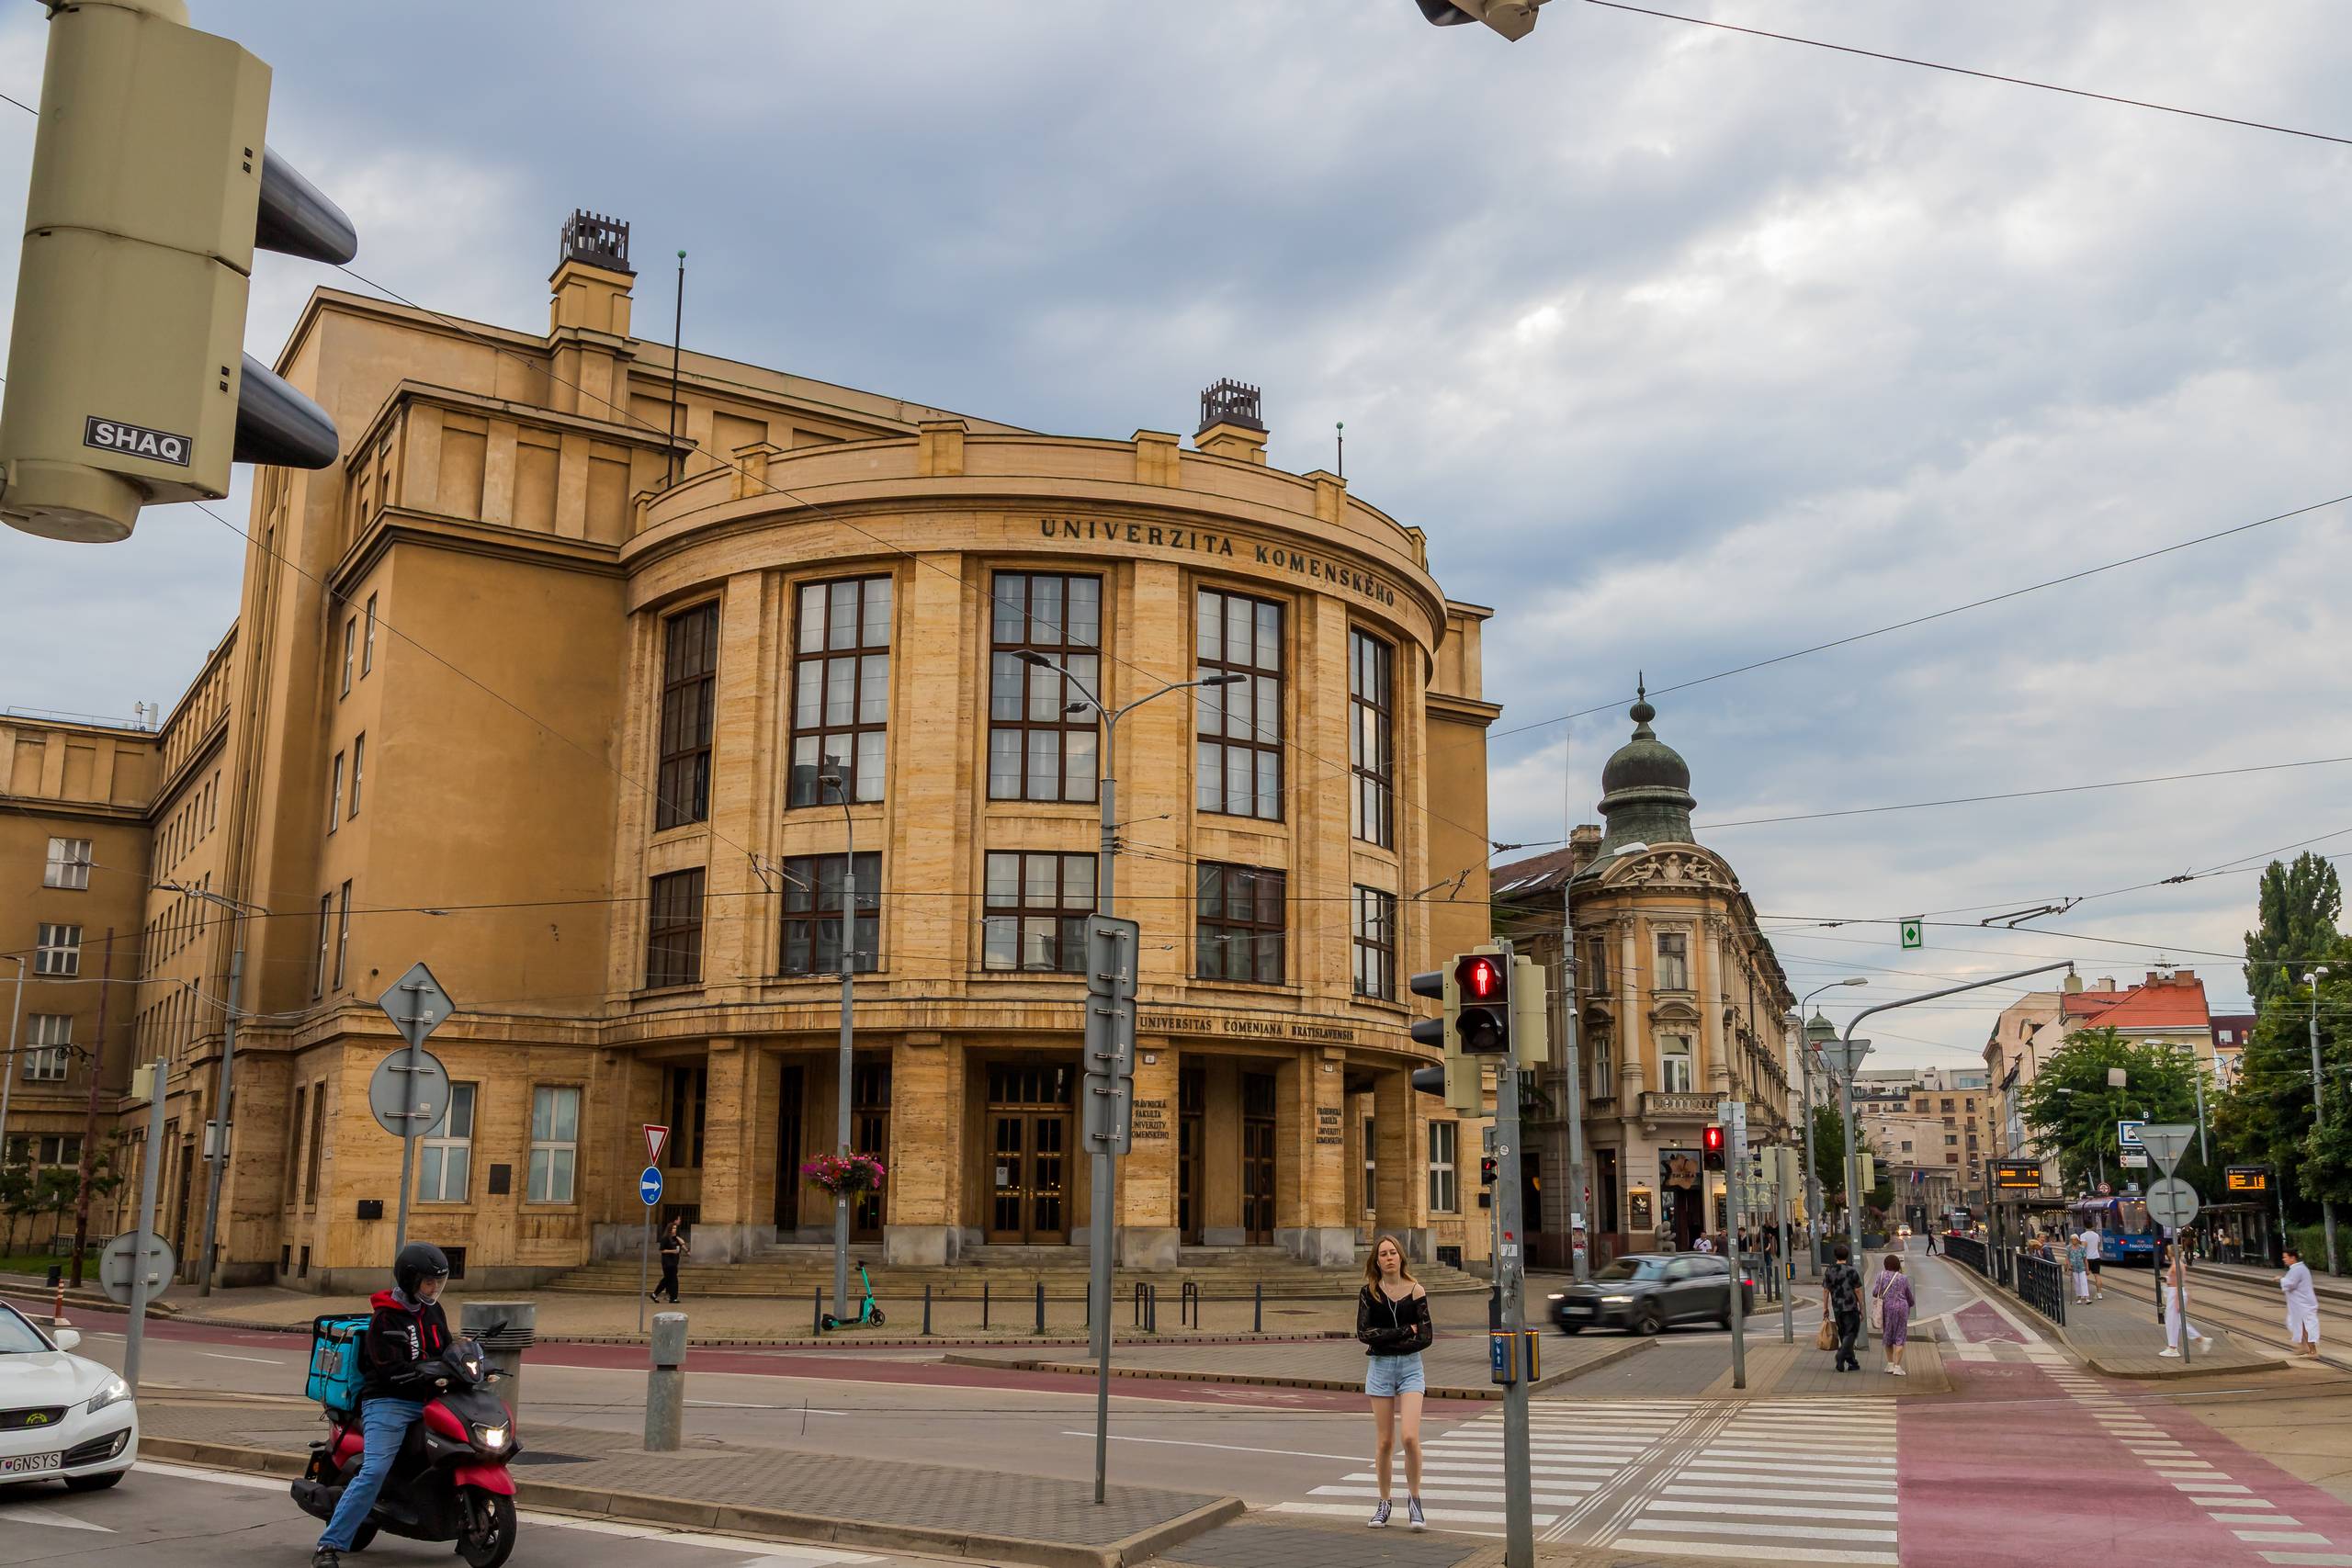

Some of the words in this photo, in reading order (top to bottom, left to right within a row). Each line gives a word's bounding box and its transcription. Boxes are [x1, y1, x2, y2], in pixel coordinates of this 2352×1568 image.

[95, 423, 182, 461] SHAQ
[1041, 519, 1234, 557] UNIVERZITA
[1256, 544, 1396, 607] KOMENSKÉHO
[1139, 1016, 1212, 1031] UNIVERSITAS
[1224, 1021, 1283, 1035] COMENIANA
[1291, 1025, 1354, 1041] BRATISLAVENSIS
[13, 1453, 59, 1472] GNSYS
